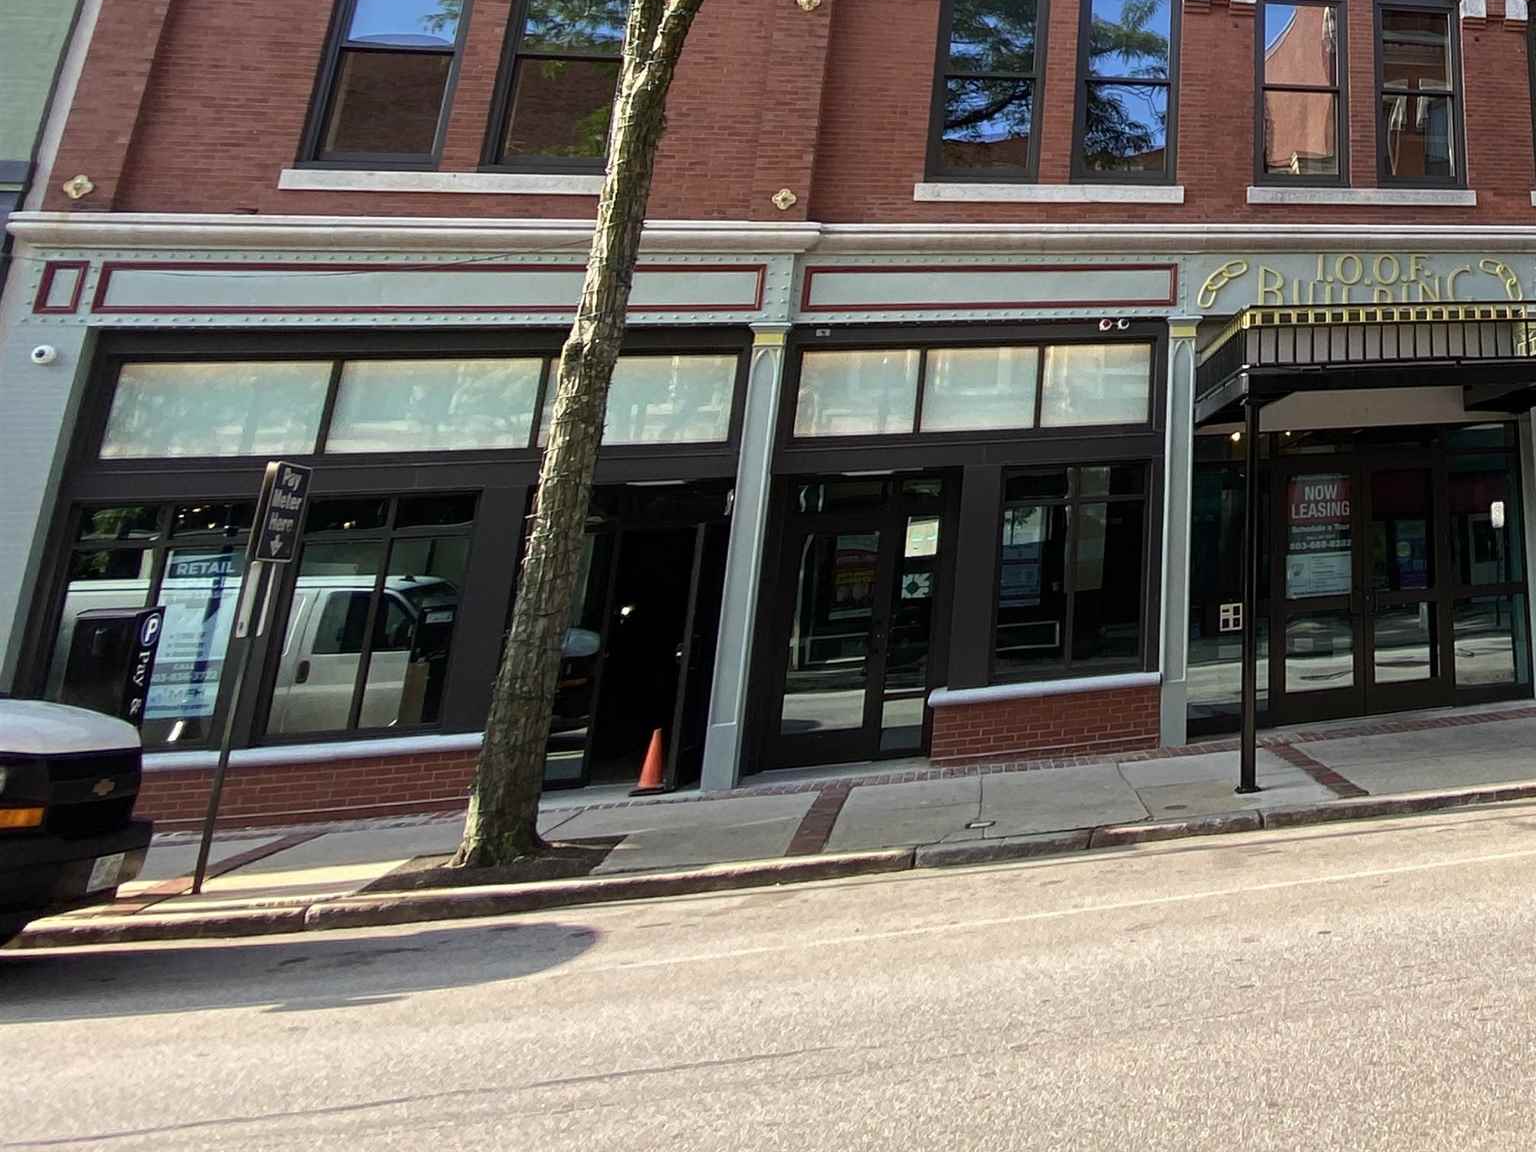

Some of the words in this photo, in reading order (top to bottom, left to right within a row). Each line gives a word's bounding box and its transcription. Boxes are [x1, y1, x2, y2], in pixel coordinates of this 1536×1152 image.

[281, 467, 303, 491] Pay
[271, 488, 302, 511] Meter
[1304, 485, 1337, 501] NOW
[1291, 500, 1350, 519] LEASING
[268, 512, 294, 533] Here
[175, 561, 236, 576] RETAIL
